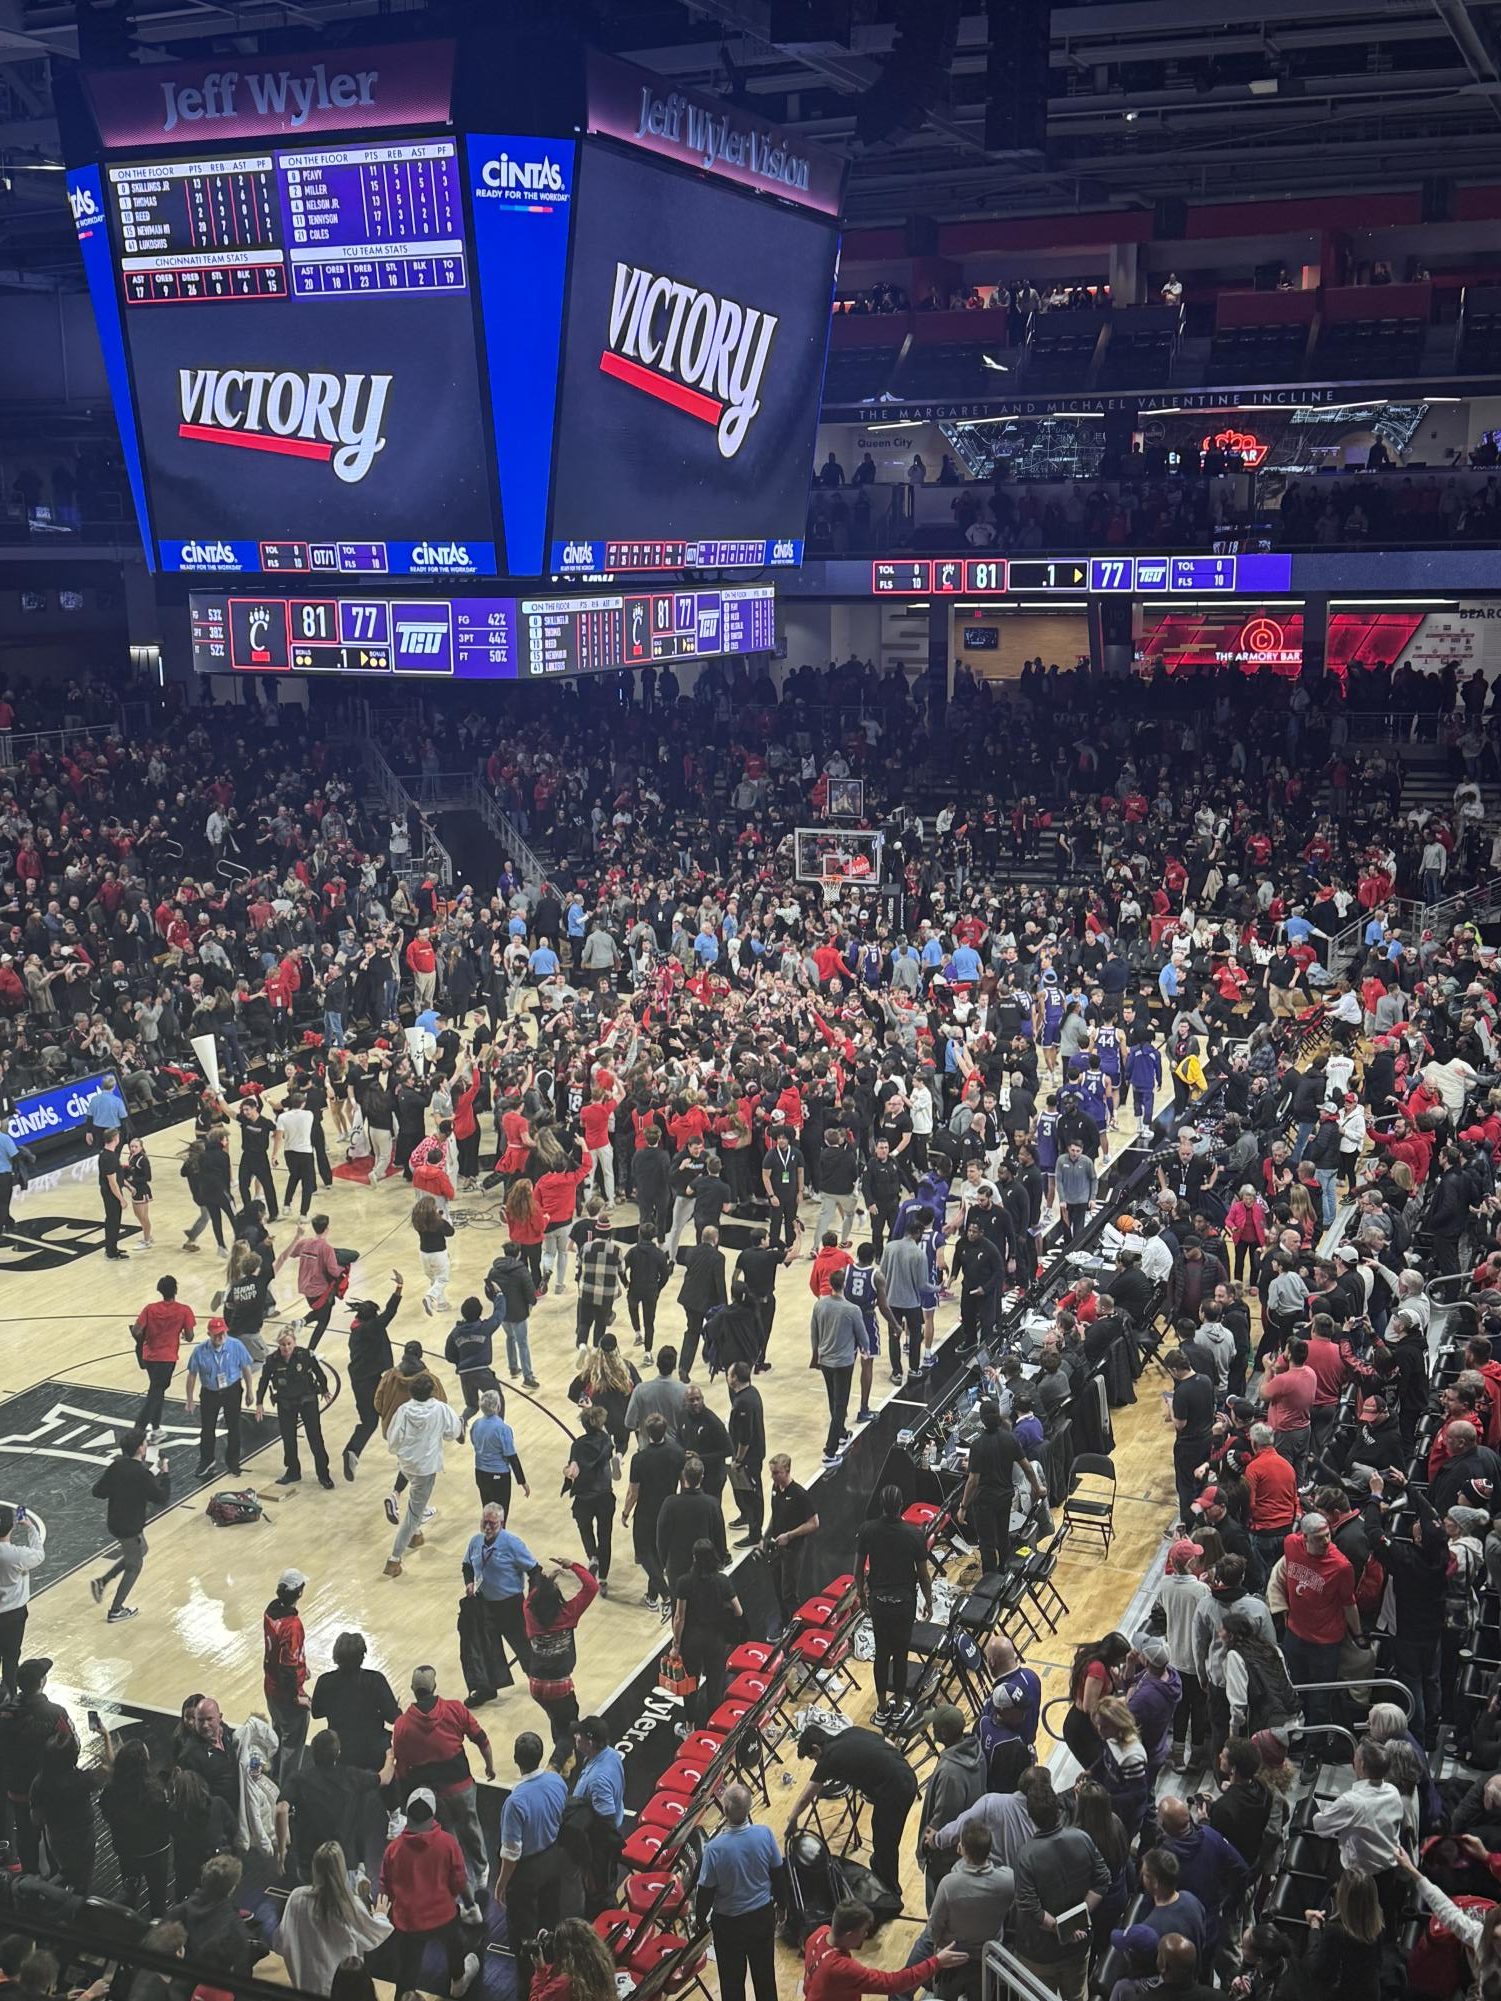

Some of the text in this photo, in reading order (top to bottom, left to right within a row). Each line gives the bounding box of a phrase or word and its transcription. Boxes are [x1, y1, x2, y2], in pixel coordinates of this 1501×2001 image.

[160, 63, 379, 132] Jeff Wyler
[634, 85, 810, 191] Jeff Wyler Vision
[288, 146, 447, 166] ON THE FLOOR PTS REB AST PF
[118, 160, 266, 178] ON THE FLOOR PTS REB AST PF
[302, 170, 322, 180] PEAVY
[370, 166, 377, 176] 11
[482, 152, 563, 191] CINTAS
[304, 180, 378, 195] MILLER 15
[476, 188, 569, 202] READY FOR THE WORKDAY
[133, 196, 158, 207] THOMAS
[306, 196, 380, 210] NELSON JR 13
[308, 211, 381, 225] TENNYSON 17
[310, 229, 330, 240] COLES
[342, 244, 408, 256] TCU TEAM STATS
[155, 254, 249, 266] CINCINNATI TEAM STATS
[301, 260, 454, 275] AST OREB DREB STL BLK TO
[132, 276, 144, 284] AST
[212, 272, 222, 280] STL
[236, 270, 250, 279] BLK
[266, 268, 276, 278] TO
[304, 279, 314, 290] 20
[360, 276, 369, 288] 23
[388, 274, 398, 286] 10
[268, 280, 277, 292] 15
[609, 261, 778, 458] VICTORY
[860, 390, 1334, 420] THE MARGARET AND MICHAEL VALENTINE INCLINE
[179, 369, 394, 483] VICTORY
[858, 439, 912, 450] Queen City
[181, 541, 236, 564] CINTAS
[314, 550, 335, 566] OT/1
[342, 546, 356, 555] TOL
[412, 542, 471, 566] CINTAS
[267, 560, 280, 568] FLS
[344, 560, 356, 568] FLS
[878, 564, 920, 576] TOL 0
[1178, 560, 1222, 572] TOL 0
[976, 564, 996, 589] 81
[1042, 565, 1055, 587] .1
[1102, 562, 1124, 588] 77
[1138, 566, 1166, 583] TCU
[1178, 574, 1224, 586] FLS 10
[879, 578, 920, 590] FLS 10
[458, 613, 506, 626] FG 42%
[658, 599, 670, 628] 81
[680, 598, 691, 627] 77
[302, 606, 326, 638] 81
[352, 607, 378, 638] 77
[396, 622, 448, 654] TCU
[458, 632, 506, 644] 3PT 44%
[336, 649, 348, 668] .1
[460, 650, 508, 662] FT 50%
[1215, 652, 1301, 662] THE ARMORY BAR
[1098, 1035, 1114, 1048] 44
[1088, 1082, 1097, 1094] 4
[568, 1093, 583, 1112] 18
[8, 1104, 60, 1138] CINTAS
[1043, 1122, 1052, 1136] 3
[852, 1278, 864, 1297] 8
